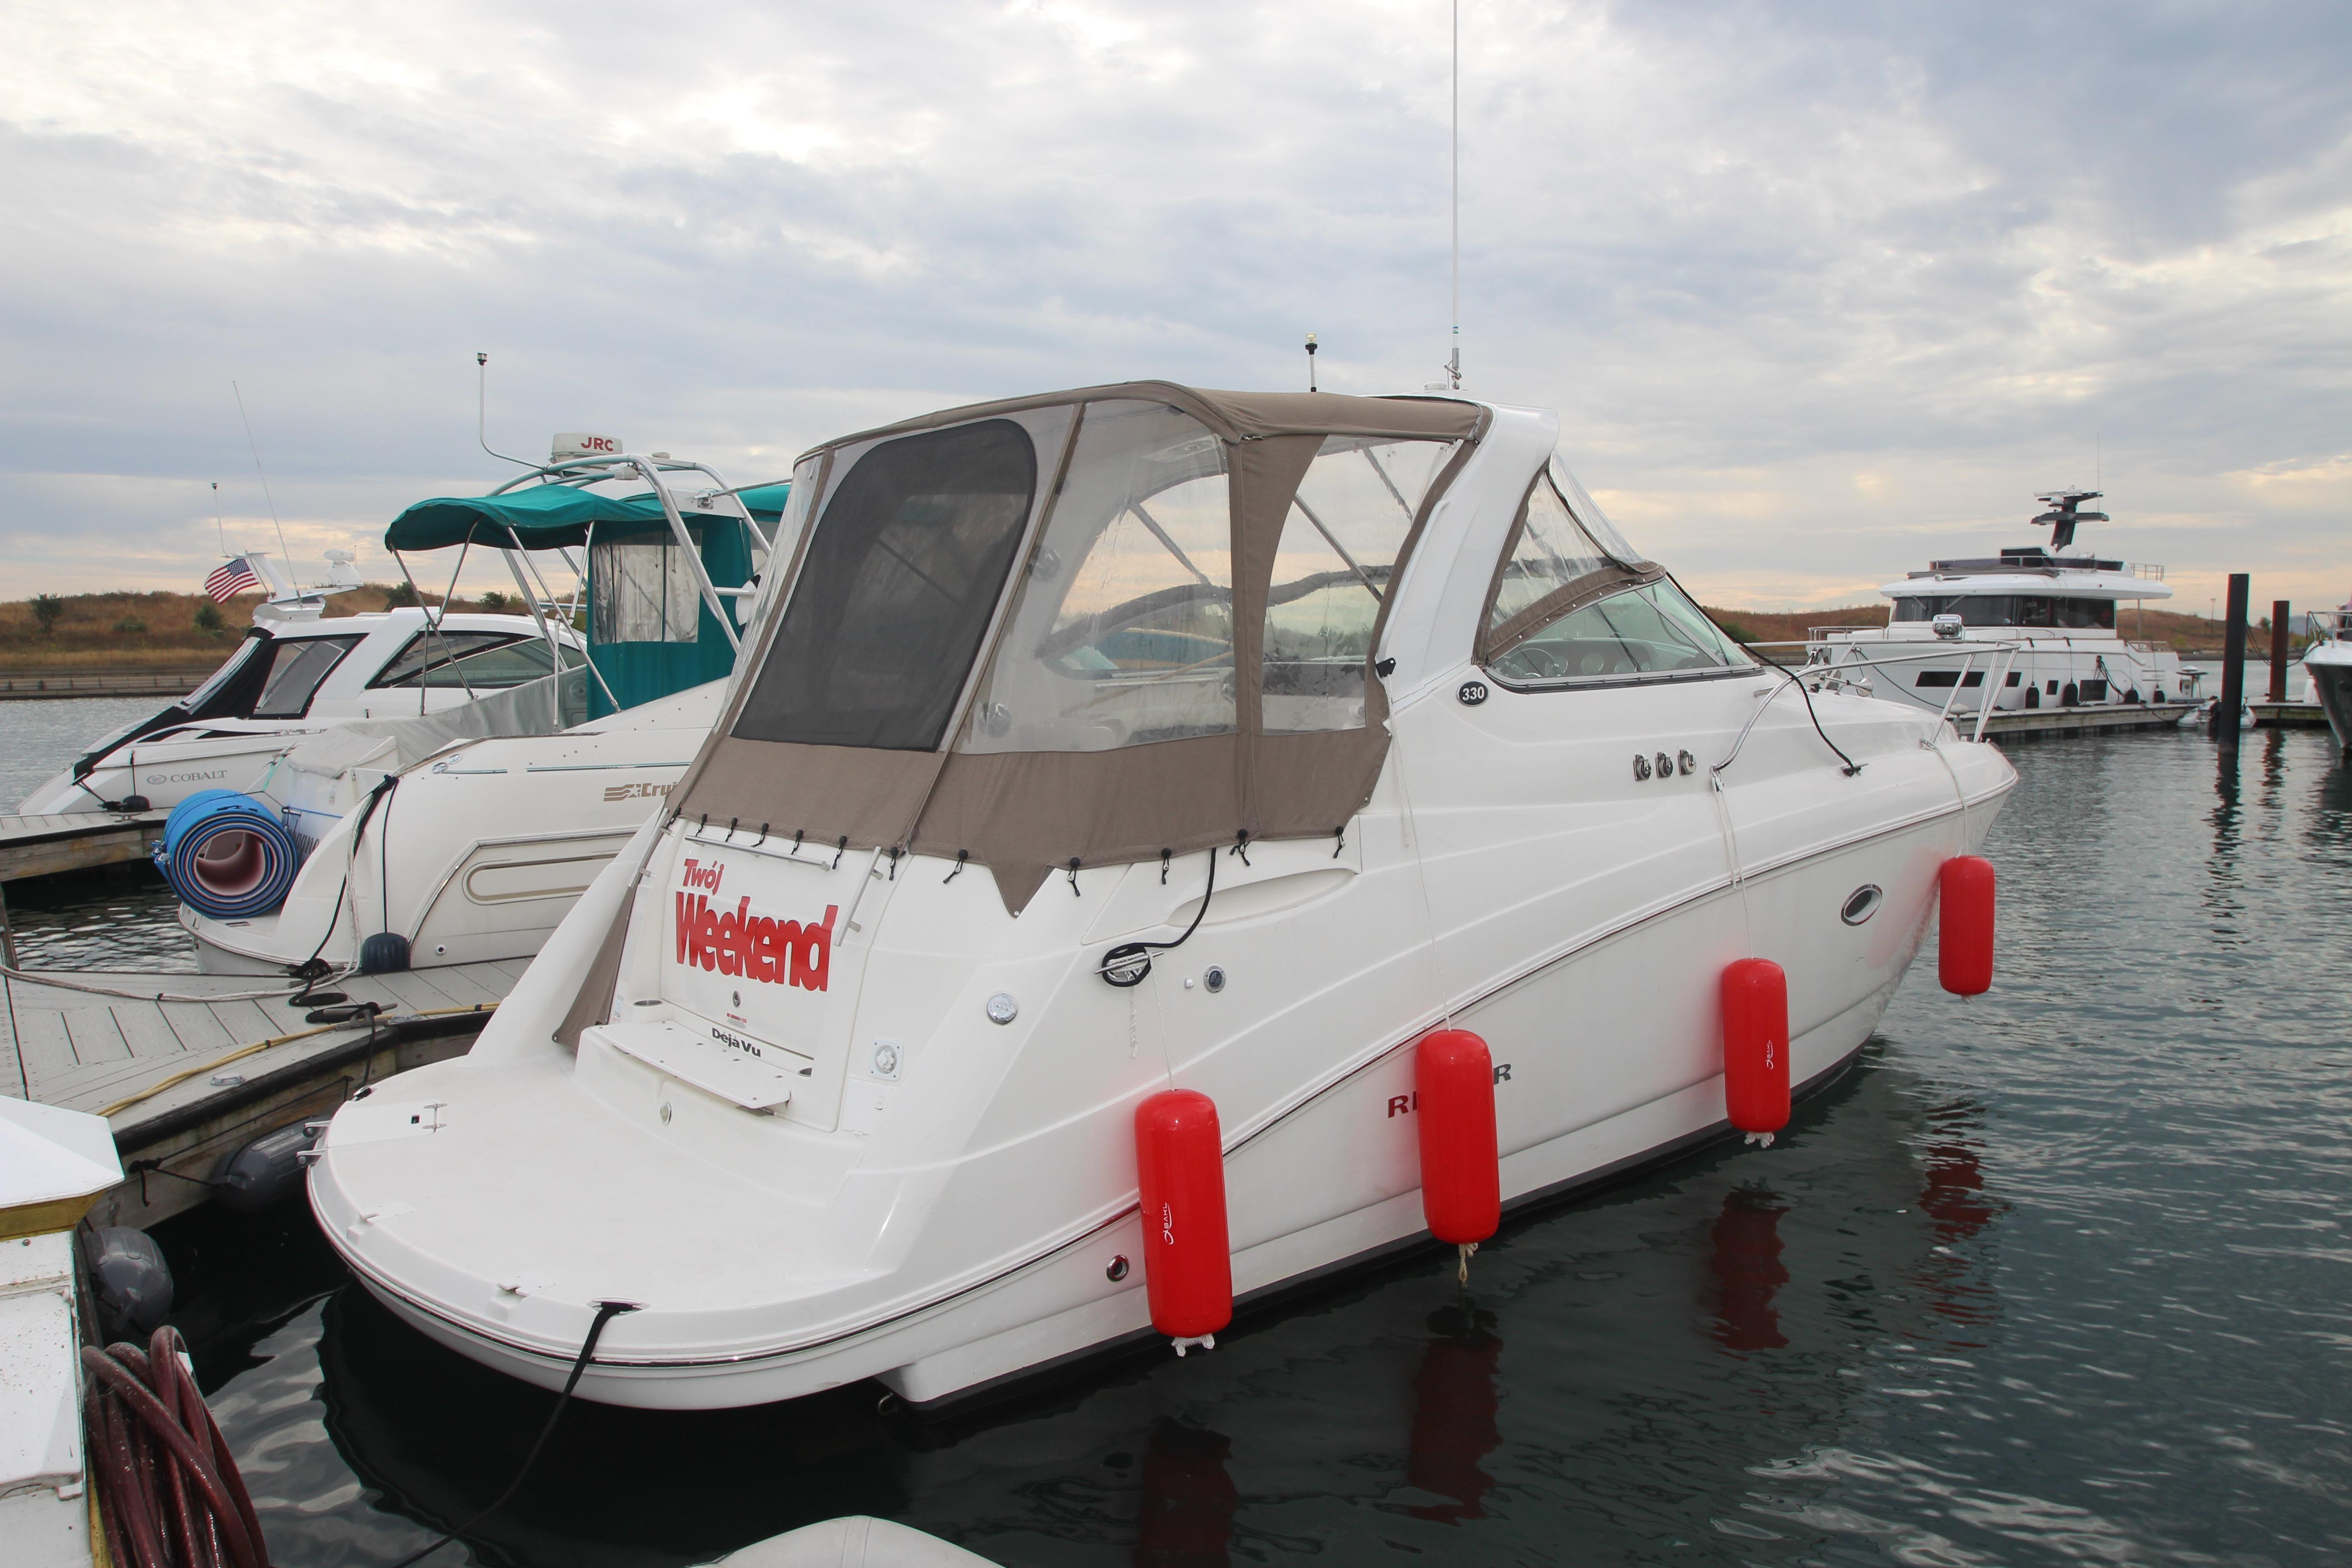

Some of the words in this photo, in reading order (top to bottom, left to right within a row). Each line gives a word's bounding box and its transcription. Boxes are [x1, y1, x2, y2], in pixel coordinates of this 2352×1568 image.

[581, 437, 613, 452] JRC
[1462, 686, 1485, 701] 330
[171, 770, 227, 783] COBALT
[682, 858, 725, 896] Twój
[676, 891, 838, 992] Weekend
[712, 1027, 740, 1049] Déjà
[740, 1039, 761, 1058] Vu
